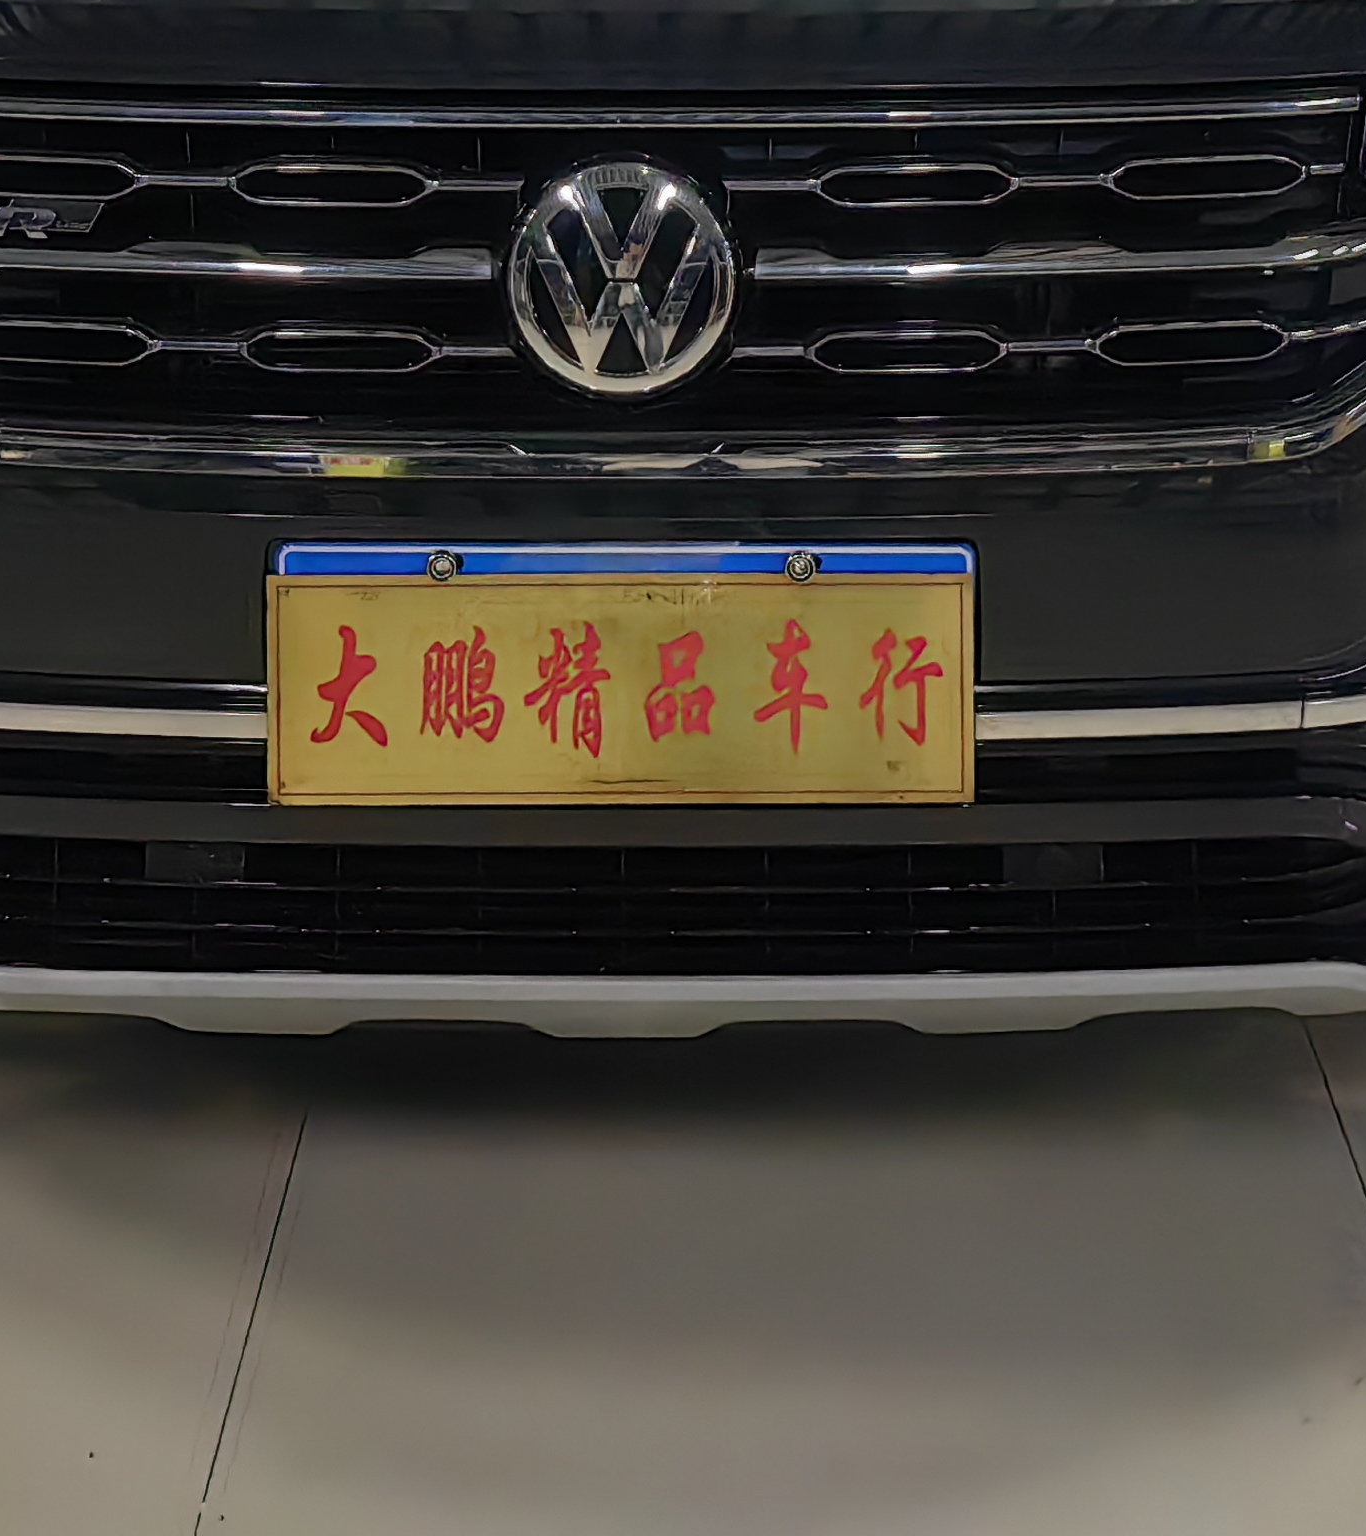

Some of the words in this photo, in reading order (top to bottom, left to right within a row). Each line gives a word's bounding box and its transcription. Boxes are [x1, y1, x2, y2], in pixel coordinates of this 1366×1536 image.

[310, 619, 944, 759] 大鹏精品车行
